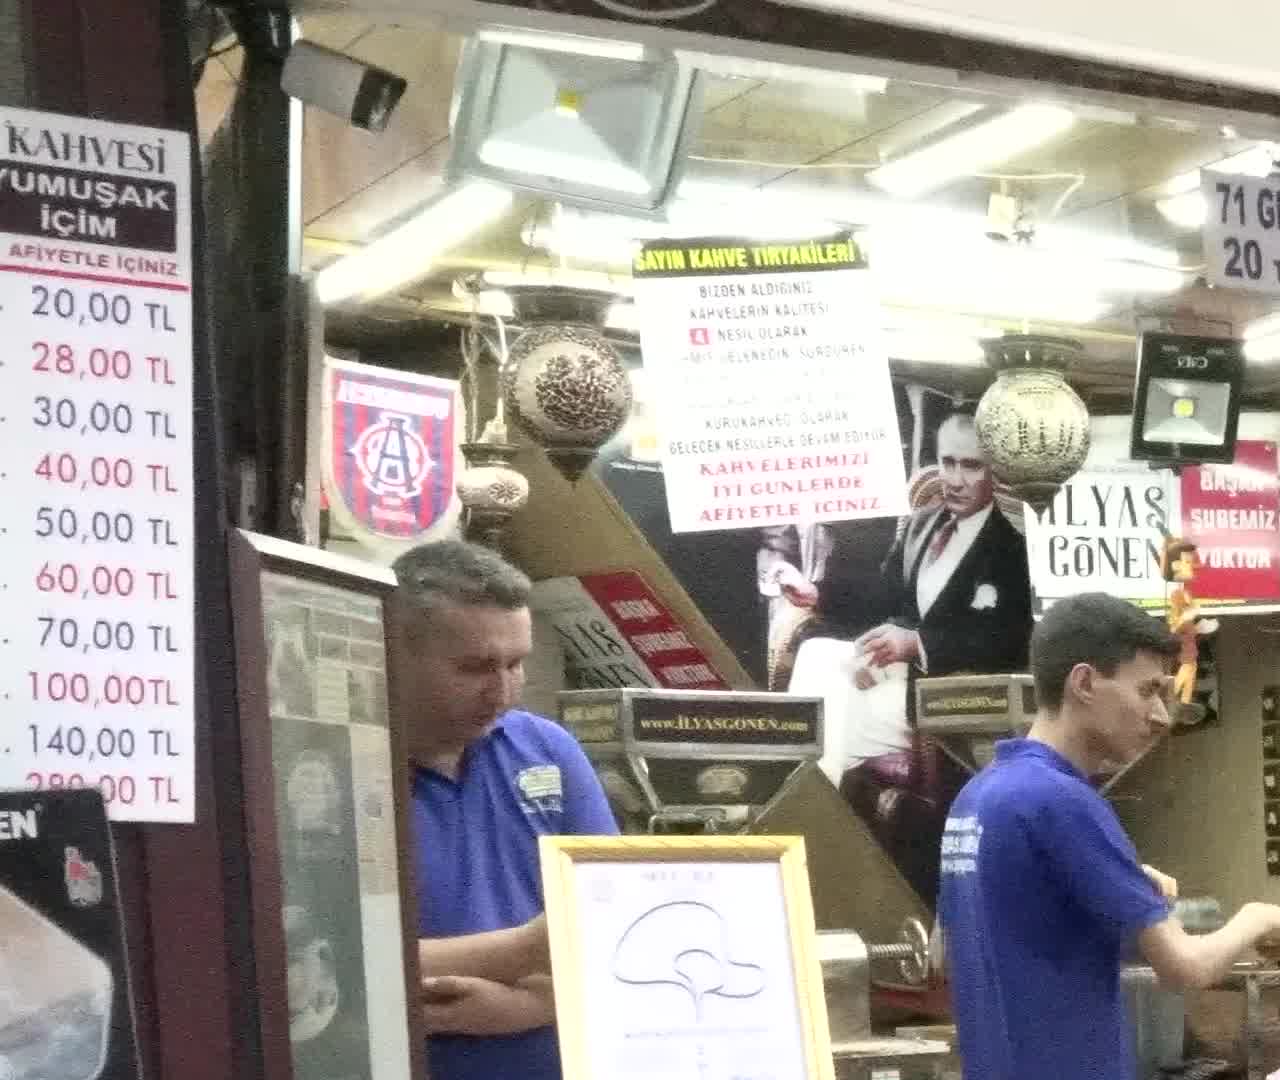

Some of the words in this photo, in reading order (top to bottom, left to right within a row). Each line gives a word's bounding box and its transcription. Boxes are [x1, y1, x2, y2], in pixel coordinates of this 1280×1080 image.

[4, 120, 166, 174] KAHVESİ
[40, 203, 117, 240] İÇİM
[1216, 184, 1246, 226] 71
[9, 243, 112, 269] AFİYETLE
[117, 253, 179, 277] İÇİNİZ
[690, 247, 748, 268] KAHVE
[1223, 238, 1263, 280] 20
[31, 284, 132, 330] 20,00
[144, 302, 177, 333] TL
[31, 341, 133, 385] 28,00
[145, 357, 177, 386] TL
[32, 396, 133, 439] 30,00
[146, 411, 177, 440] TL
[33, 453, 133, 494] 40,00
[146, 465, 178, 494] TL
[35, 507, 134, 549] 50,00
[147, 517, 178, 547] TL
[1191, 504, 1276, 534] ŞUBEMİZ
[1198, 547, 1272, 569] YOKTUR
[35, 561, 134, 603] 60,00
[148, 572, 178, 600] TL
[37, 616, 135, 658] 70,00
[148, 625, 179, 653] TL
[29, 724, 135, 763] 140,00
[148, 730, 180, 757] TL
[148, 776, 180, 804] TL
